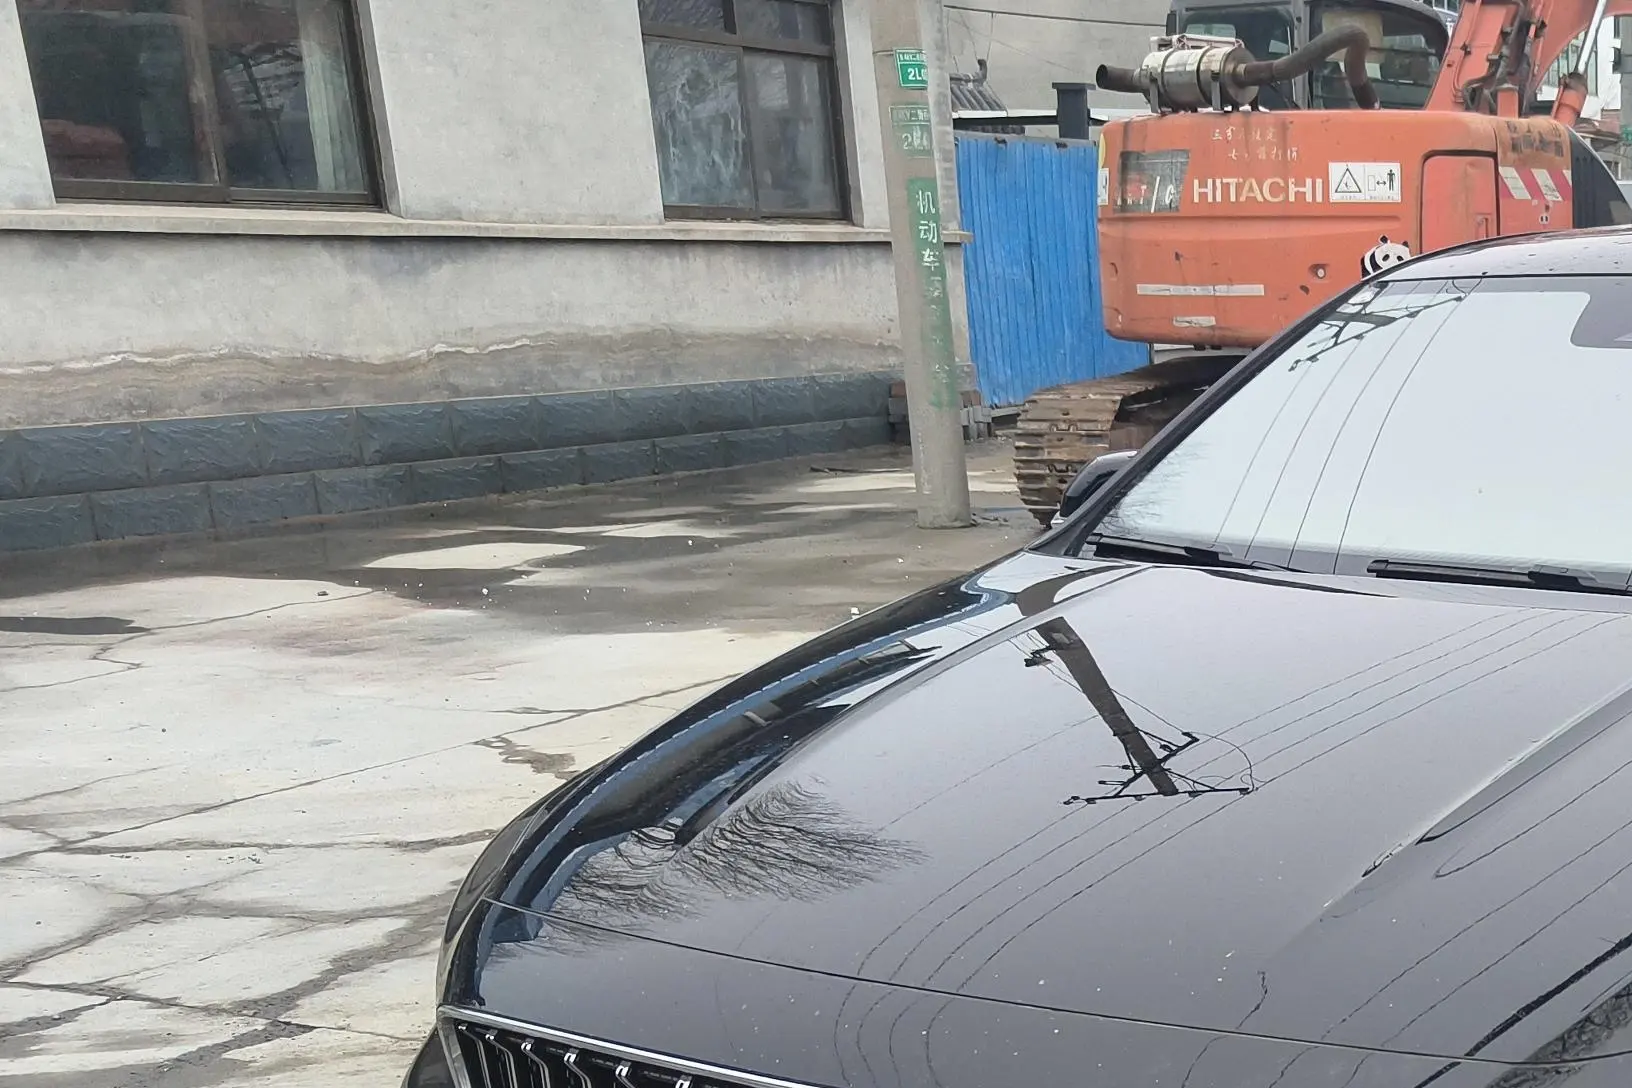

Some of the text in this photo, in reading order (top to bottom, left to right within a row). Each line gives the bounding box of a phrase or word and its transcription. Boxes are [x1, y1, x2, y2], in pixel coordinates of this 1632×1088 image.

[1193, 177, 1323, 203] HITACHI
[915, 189, 940, 271] 机动车
